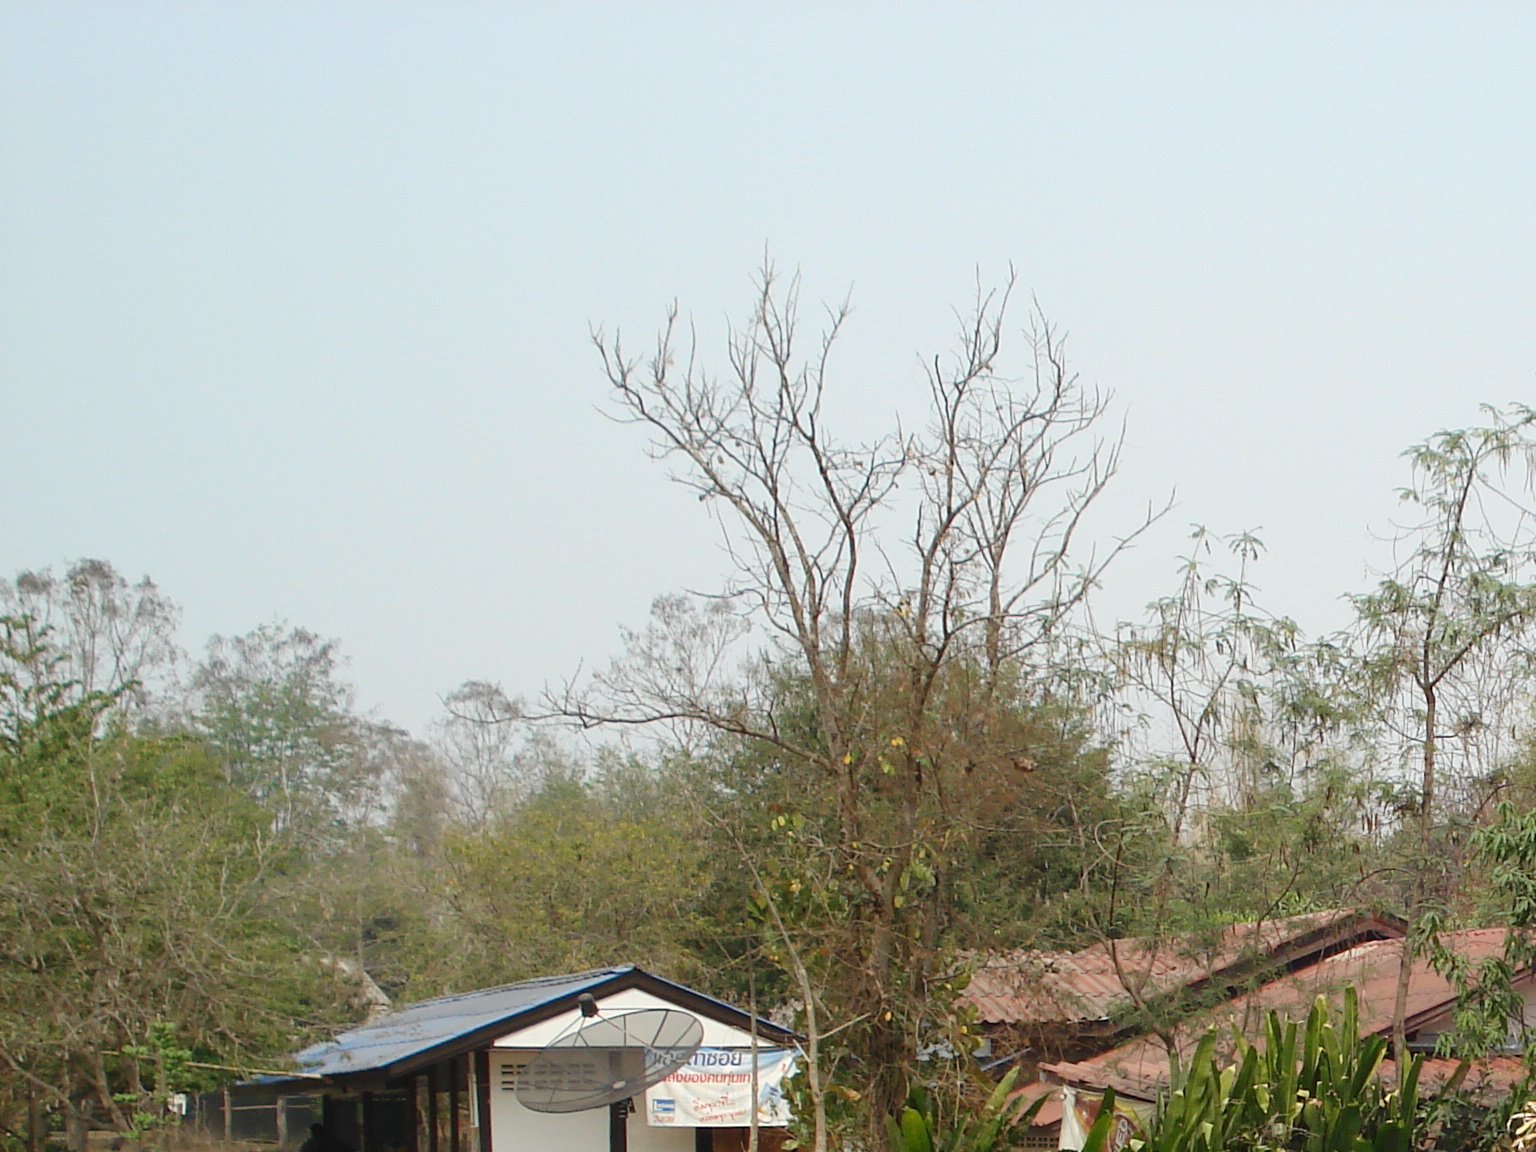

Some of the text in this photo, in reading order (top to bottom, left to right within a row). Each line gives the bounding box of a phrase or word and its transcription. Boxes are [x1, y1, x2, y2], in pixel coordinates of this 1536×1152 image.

[662, 1071, 751, 1086] ลังของคนทุ่มเท
